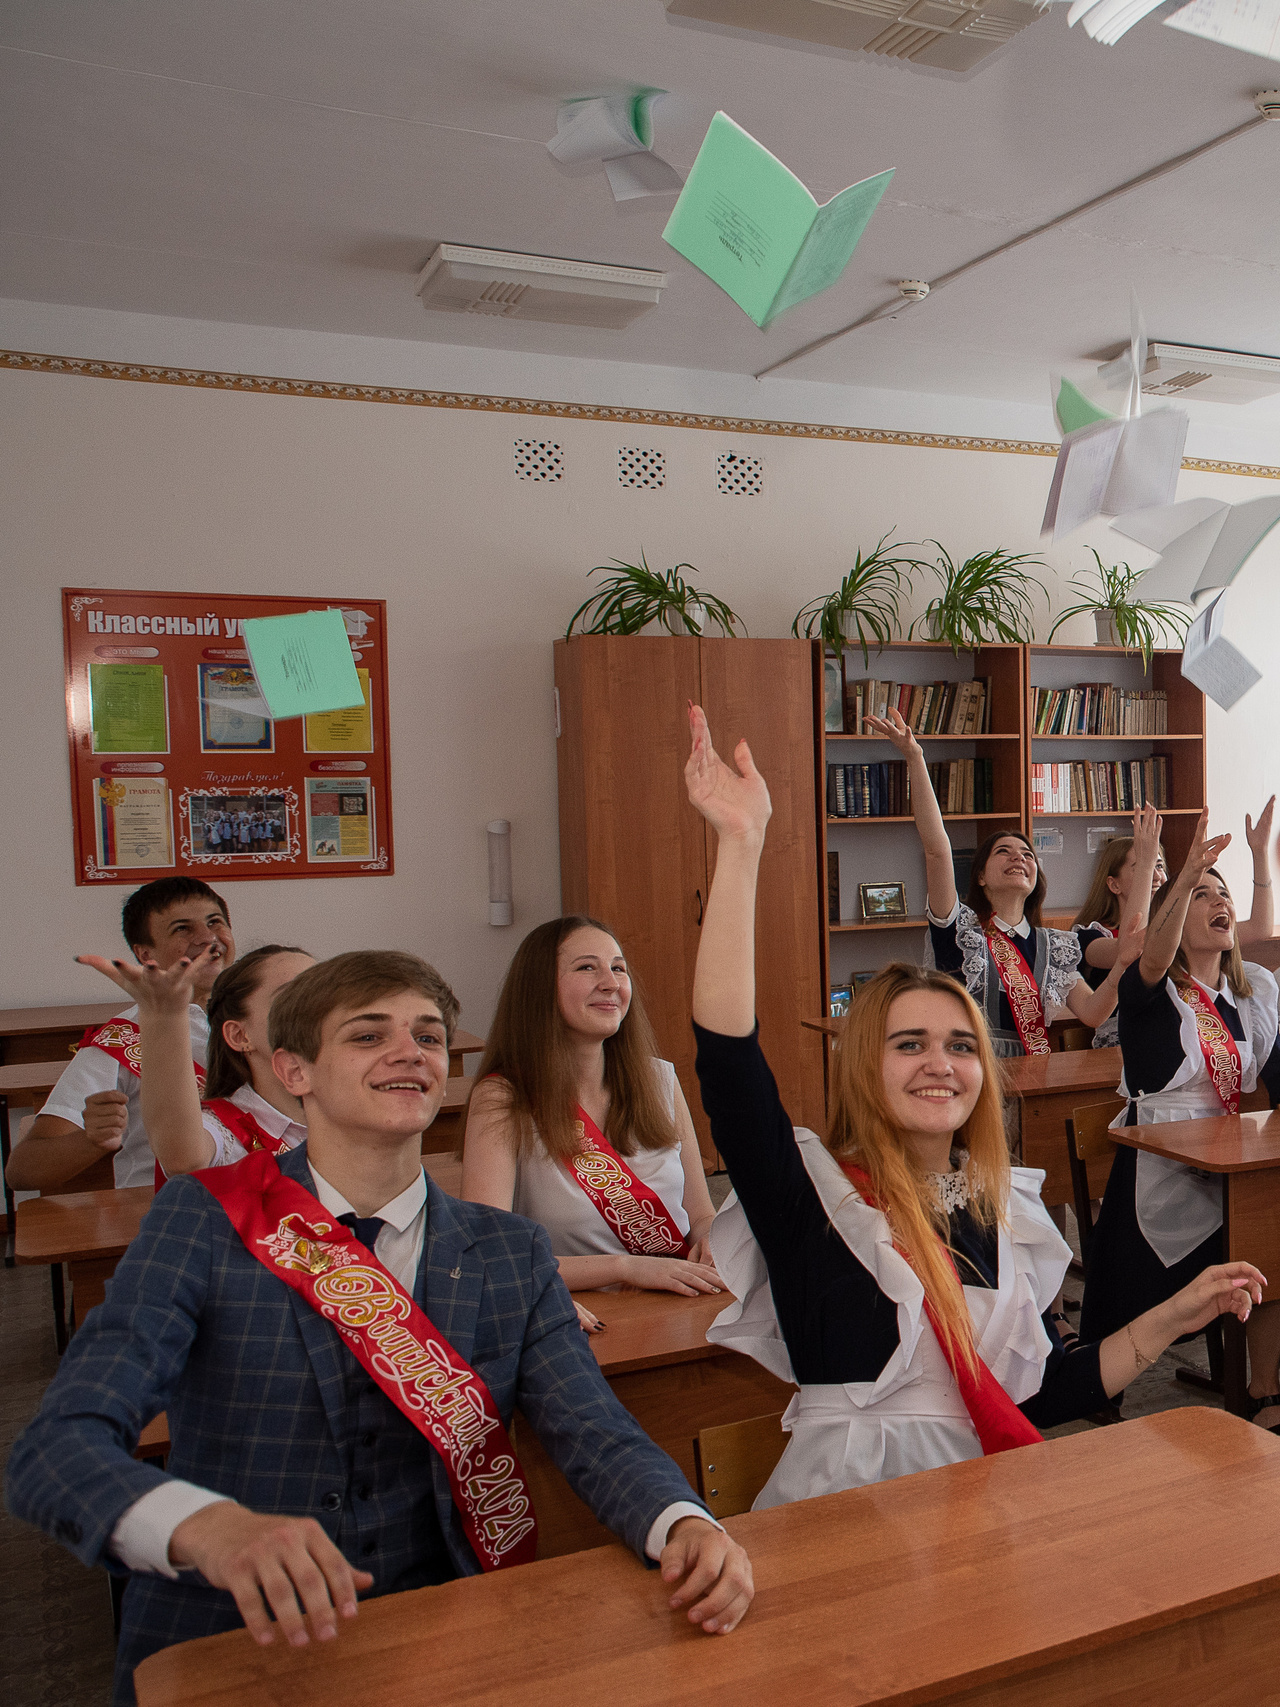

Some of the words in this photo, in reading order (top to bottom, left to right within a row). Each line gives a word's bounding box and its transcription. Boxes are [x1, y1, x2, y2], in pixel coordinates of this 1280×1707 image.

[87, 610, 220, 637] Классный
[313, 1265, 500, 1481] Выпускник
[466, 1454, 535, 1556] 2020
